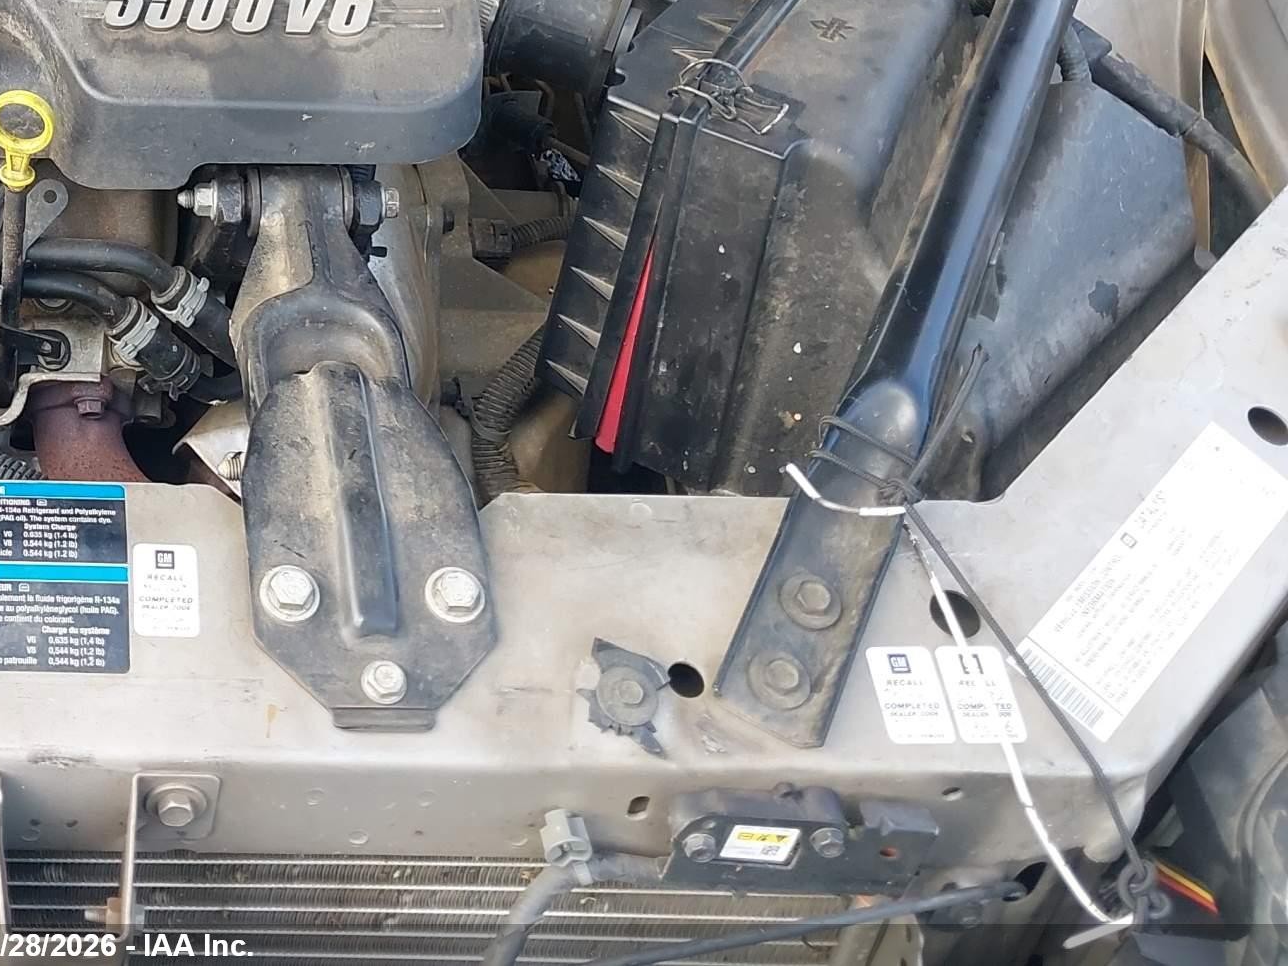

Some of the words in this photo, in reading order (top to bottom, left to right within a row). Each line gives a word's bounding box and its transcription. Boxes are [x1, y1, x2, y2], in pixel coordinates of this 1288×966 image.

[44, 550, 53, 558] kg
[70, 637, 79, 645] kg
[70, 648, 79, 656] kg
[70, 658, 79, 667] kg
